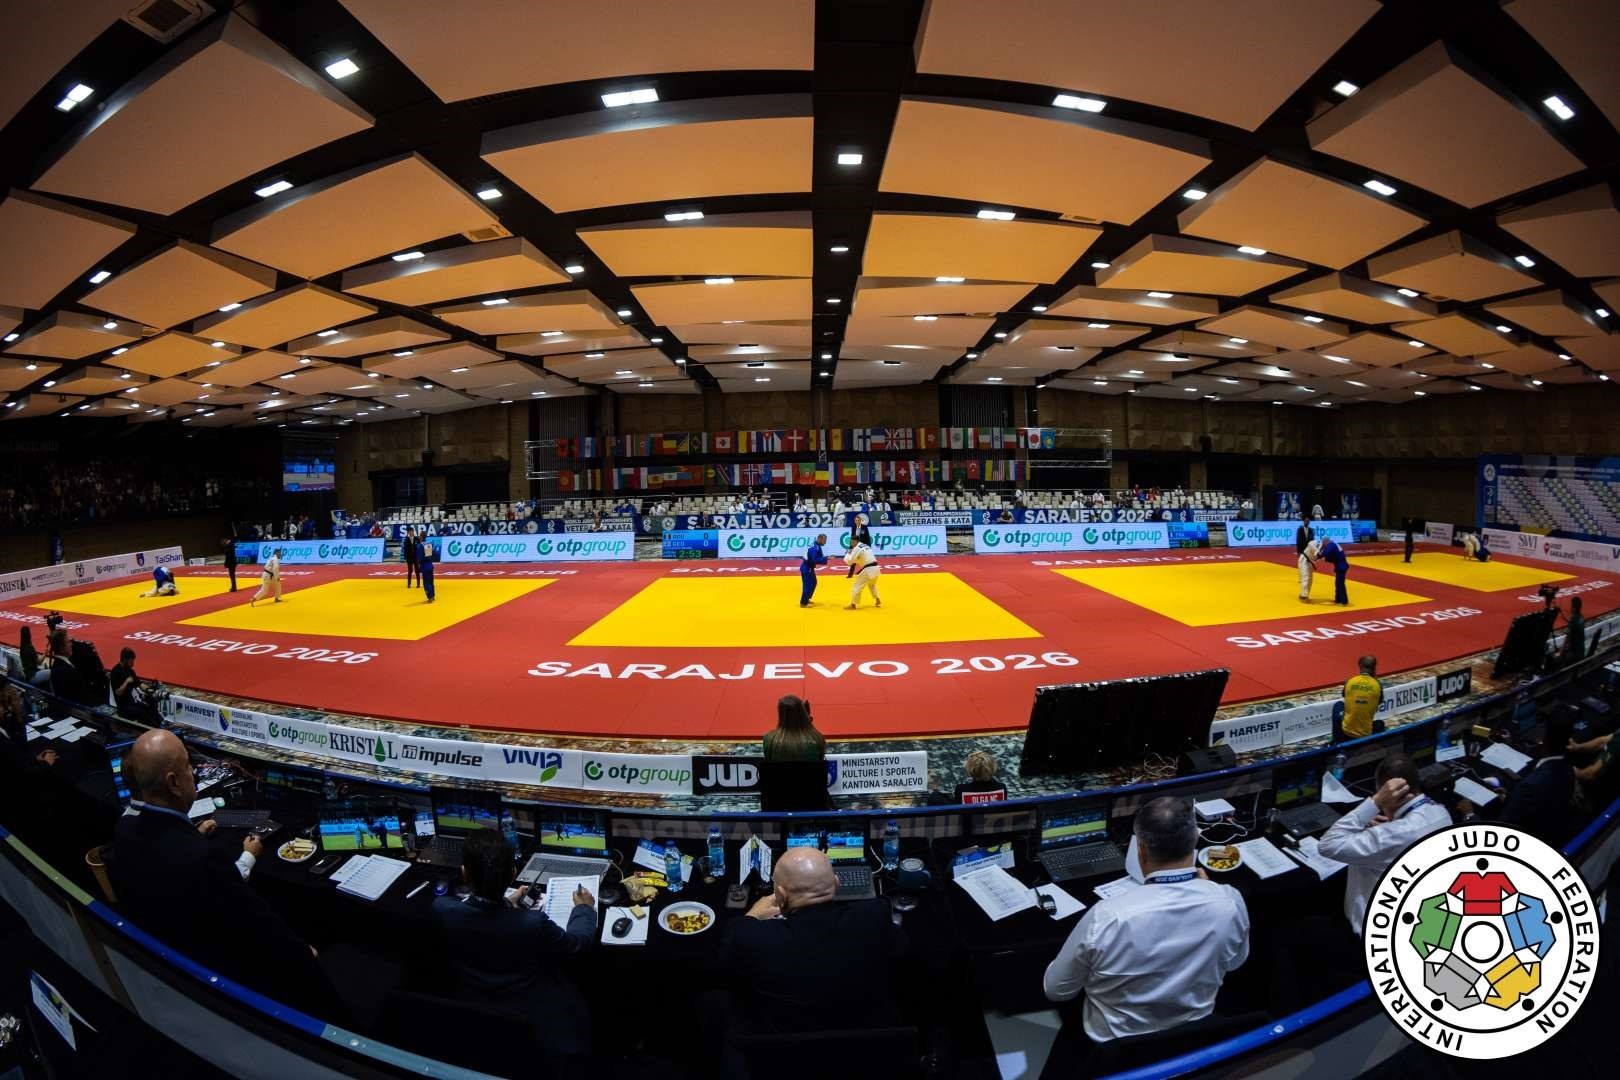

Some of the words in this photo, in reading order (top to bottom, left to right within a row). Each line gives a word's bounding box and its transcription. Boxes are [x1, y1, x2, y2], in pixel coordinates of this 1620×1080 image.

[490, 522, 517, 535] 026
[688, 514, 788, 530] SRAJEVO
[797, 513, 832, 528] 202
[750, 533, 816, 555] otpgrou
[1004, 530, 1072, 547] otpgroup
[1102, 529, 1162, 545] otpgroup
[331, 545, 378, 559] otpgroup
[464, 541, 527, 557] otpgroup
[556, 539, 626, 556] otpgroup
[154, 554, 183, 564] TaiShan
[1226, 615, 1426, 649] SARAJEVO
[1420, 606, 1482, 622] 2026
[124, 631, 279, 655] SARAJEVO
[273, 647, 380, 664] 2026
[528, 660, 909, 681] SARAJEVO
[930, 651, 1079, 674] 2026
[1438, 674, 1464, 696] JUDO
[1395, 681, 1436, 708] KRISTAL
[184, 703, 216, 718] HARVEST
[281, 726, 327, 747] otpgroup
[1229, 720, 1281, 738] HARVEST
[329, 732, 398, 763] KRISTAL
[418, 746, 483, 767] impulse
[841, 756, 900, 766] MINISTARSTVO
[608, 764, 691, 786] otpgroup
[699, 763, 760, 787] JUD
[842, 768, 879, 778] KULTURE
[885, 767, 916, 777] SPORTA
[842, 779, 881, 789] KANTONA
[882, 777, 923, 788] SARAJEVO
